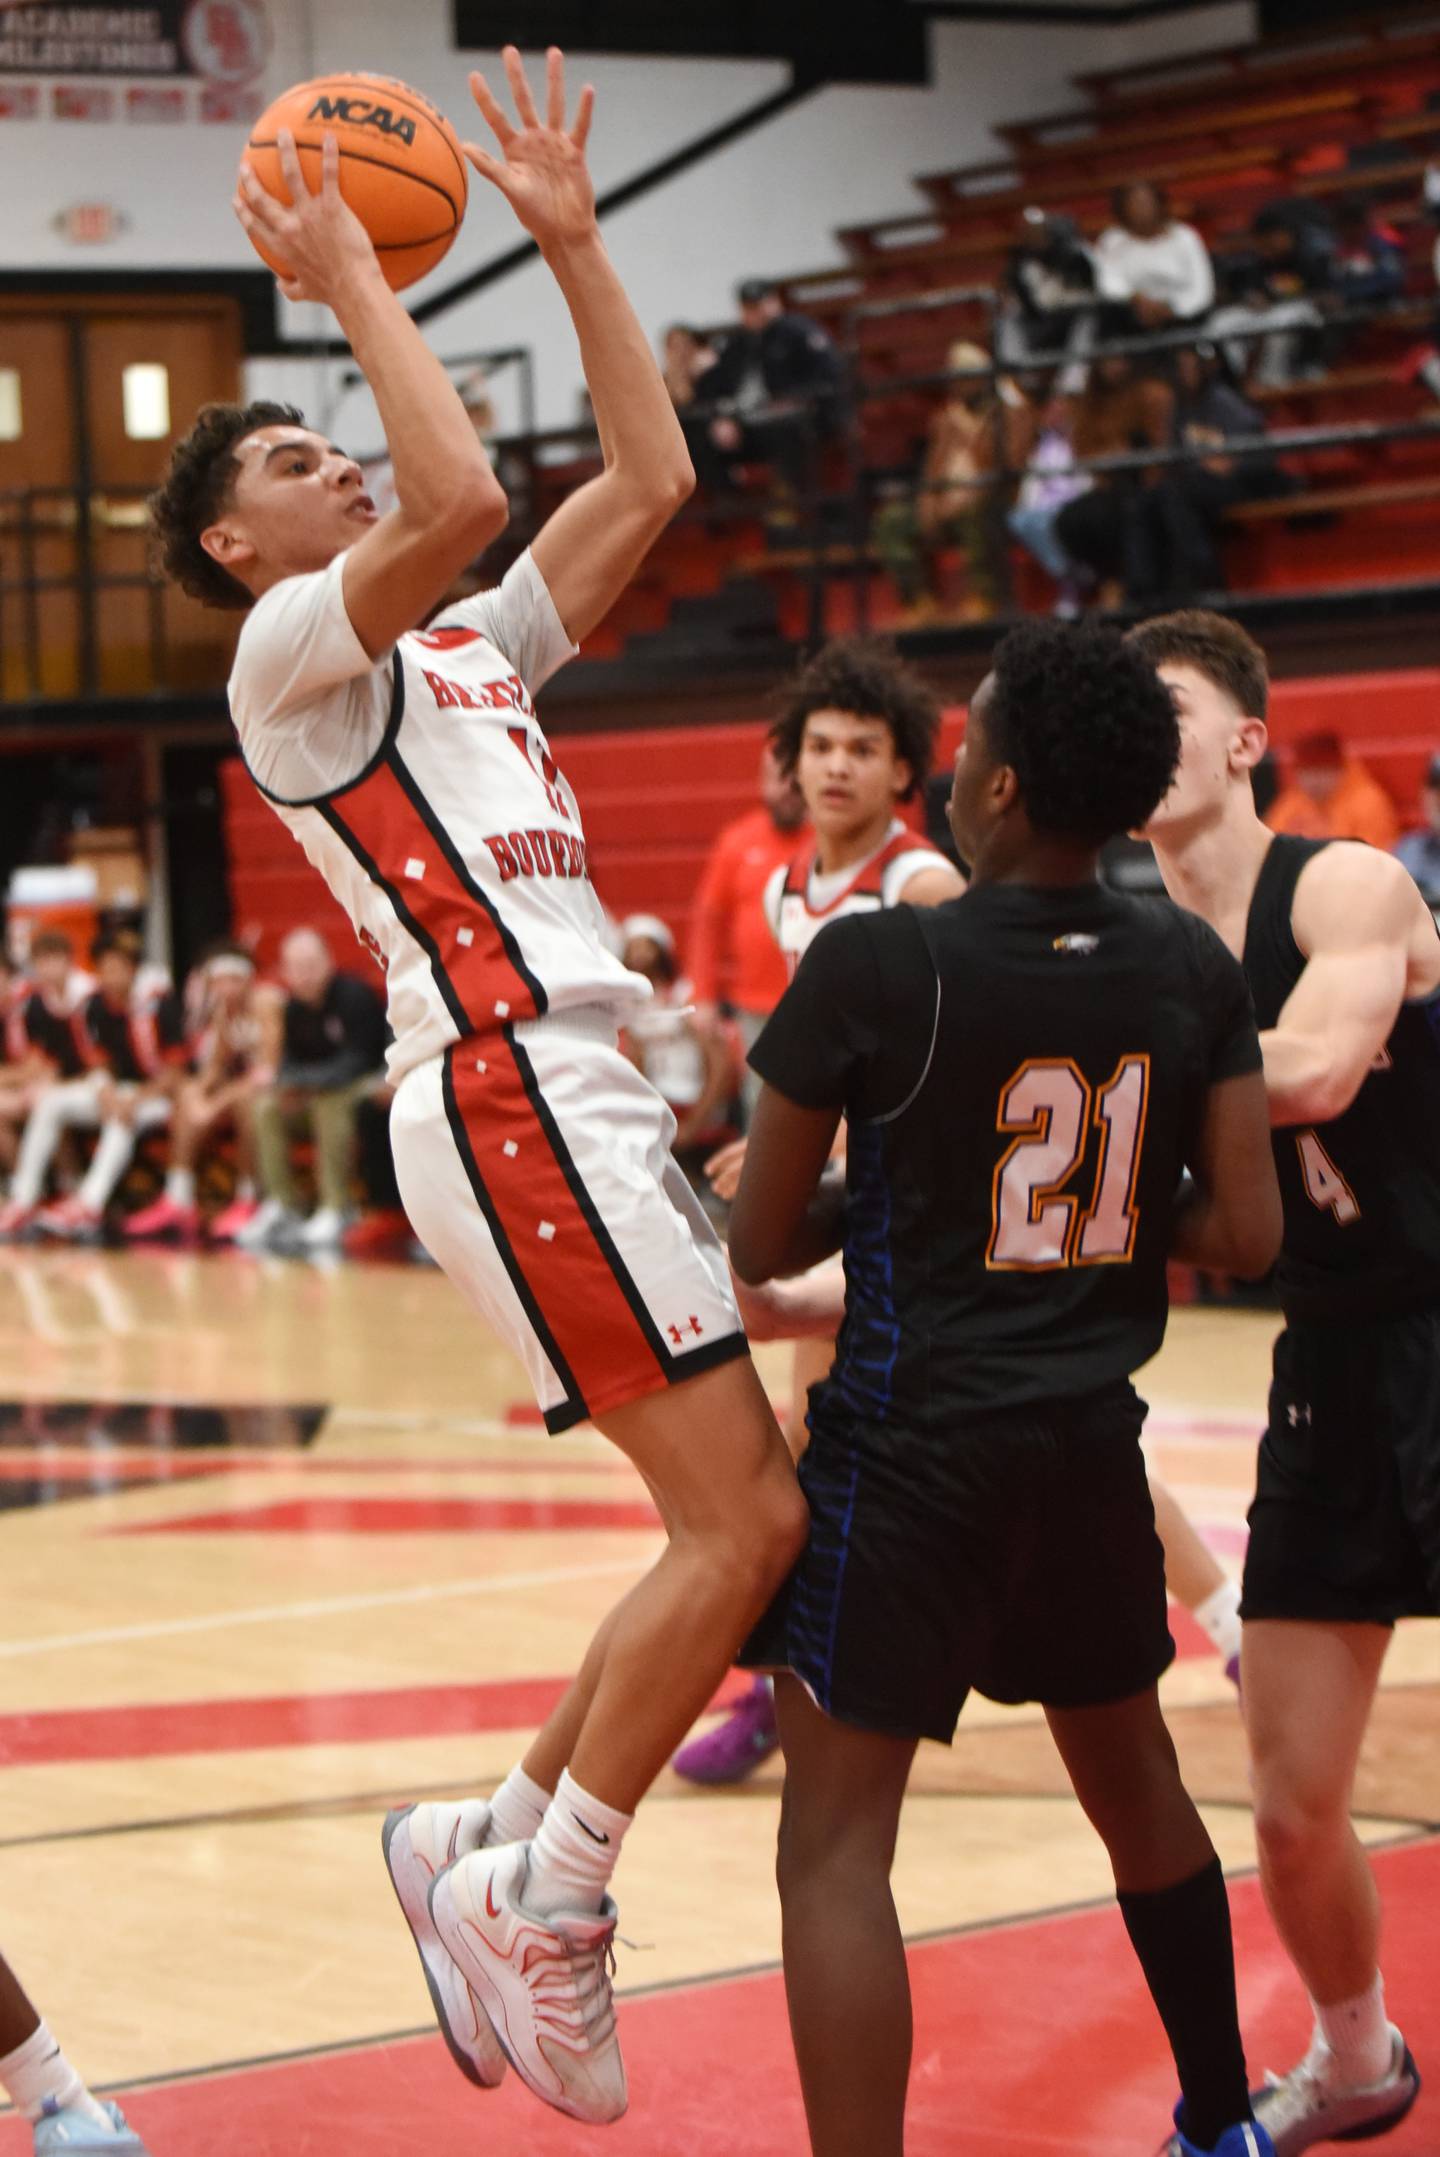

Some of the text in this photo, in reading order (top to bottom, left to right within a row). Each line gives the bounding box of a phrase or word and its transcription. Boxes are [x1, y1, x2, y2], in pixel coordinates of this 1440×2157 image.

[2, 9, 161, 39] ACADEMIC
[307, 96, 416, 146] NCAA
[985, 1053, 1150, 1270] 21
[1297, 1129, 1362, 1227] 4
